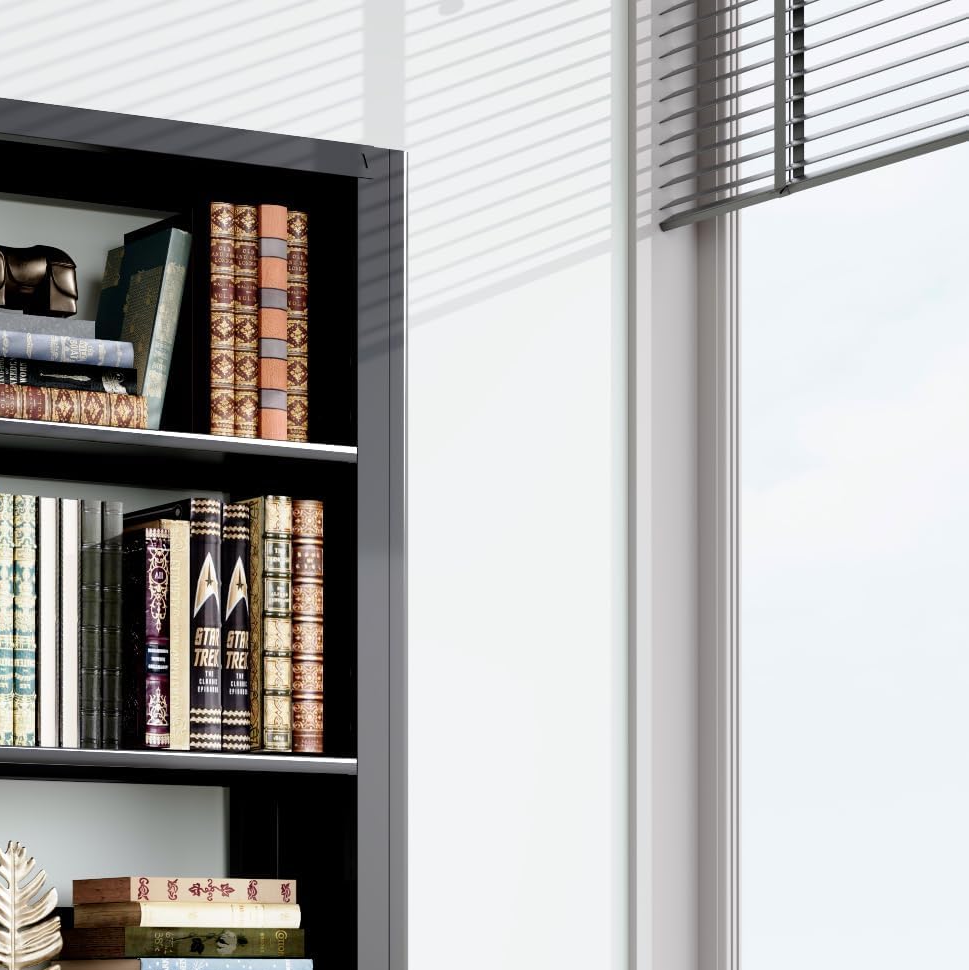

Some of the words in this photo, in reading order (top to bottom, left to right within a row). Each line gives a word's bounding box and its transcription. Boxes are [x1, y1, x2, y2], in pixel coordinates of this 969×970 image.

[194, 627, 220, 647] STAR
[194, 648, 220, 667] TREK
[205, 670, 214, 678] THE
